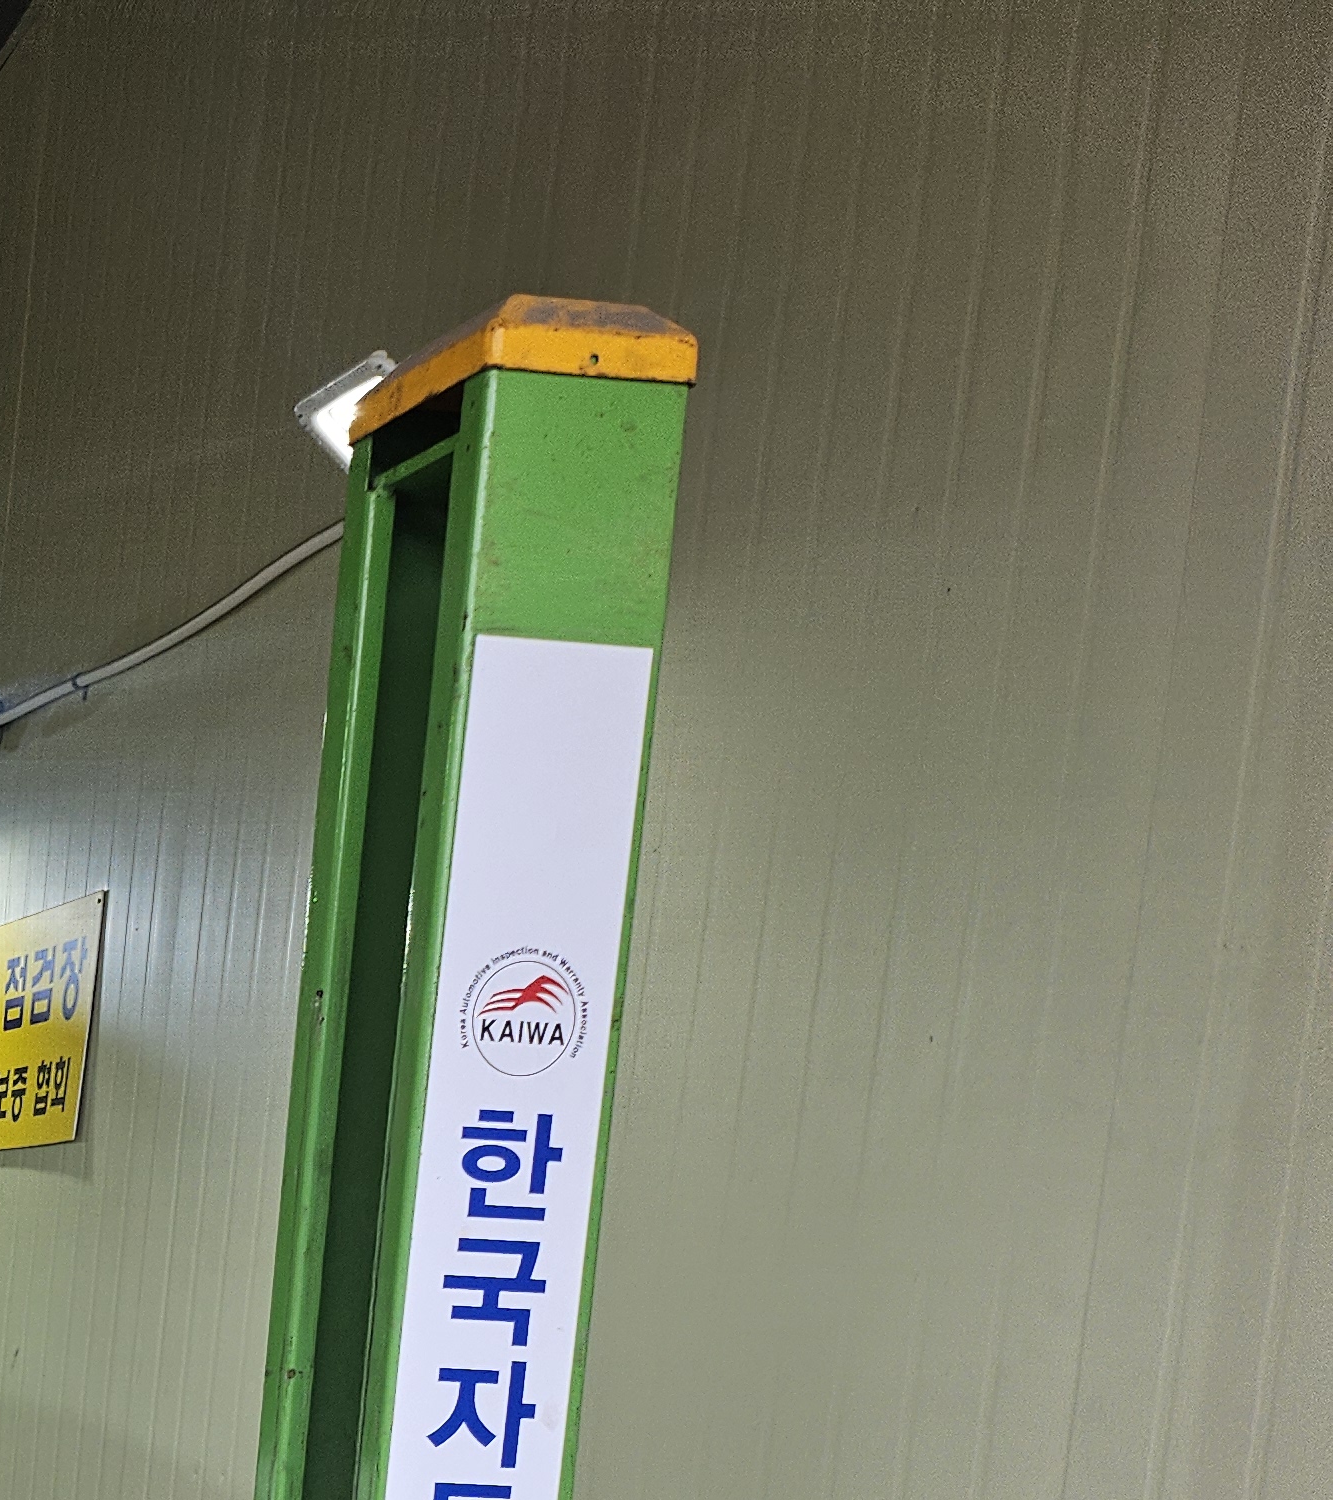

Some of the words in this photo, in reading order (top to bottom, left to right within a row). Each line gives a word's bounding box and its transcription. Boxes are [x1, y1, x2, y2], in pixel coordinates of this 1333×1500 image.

[541, 949, 559, 962] and
[2, 936, 88, 1032] 점검장
[459, 964, 491, 1016] Automotive
[559, 958, 586, 997] Warranty
[459, 1018, 470, 1049] Korea
[479, 1018, 565, 1046] KAIWA
[32, 1055, 72, 1118] 협회
